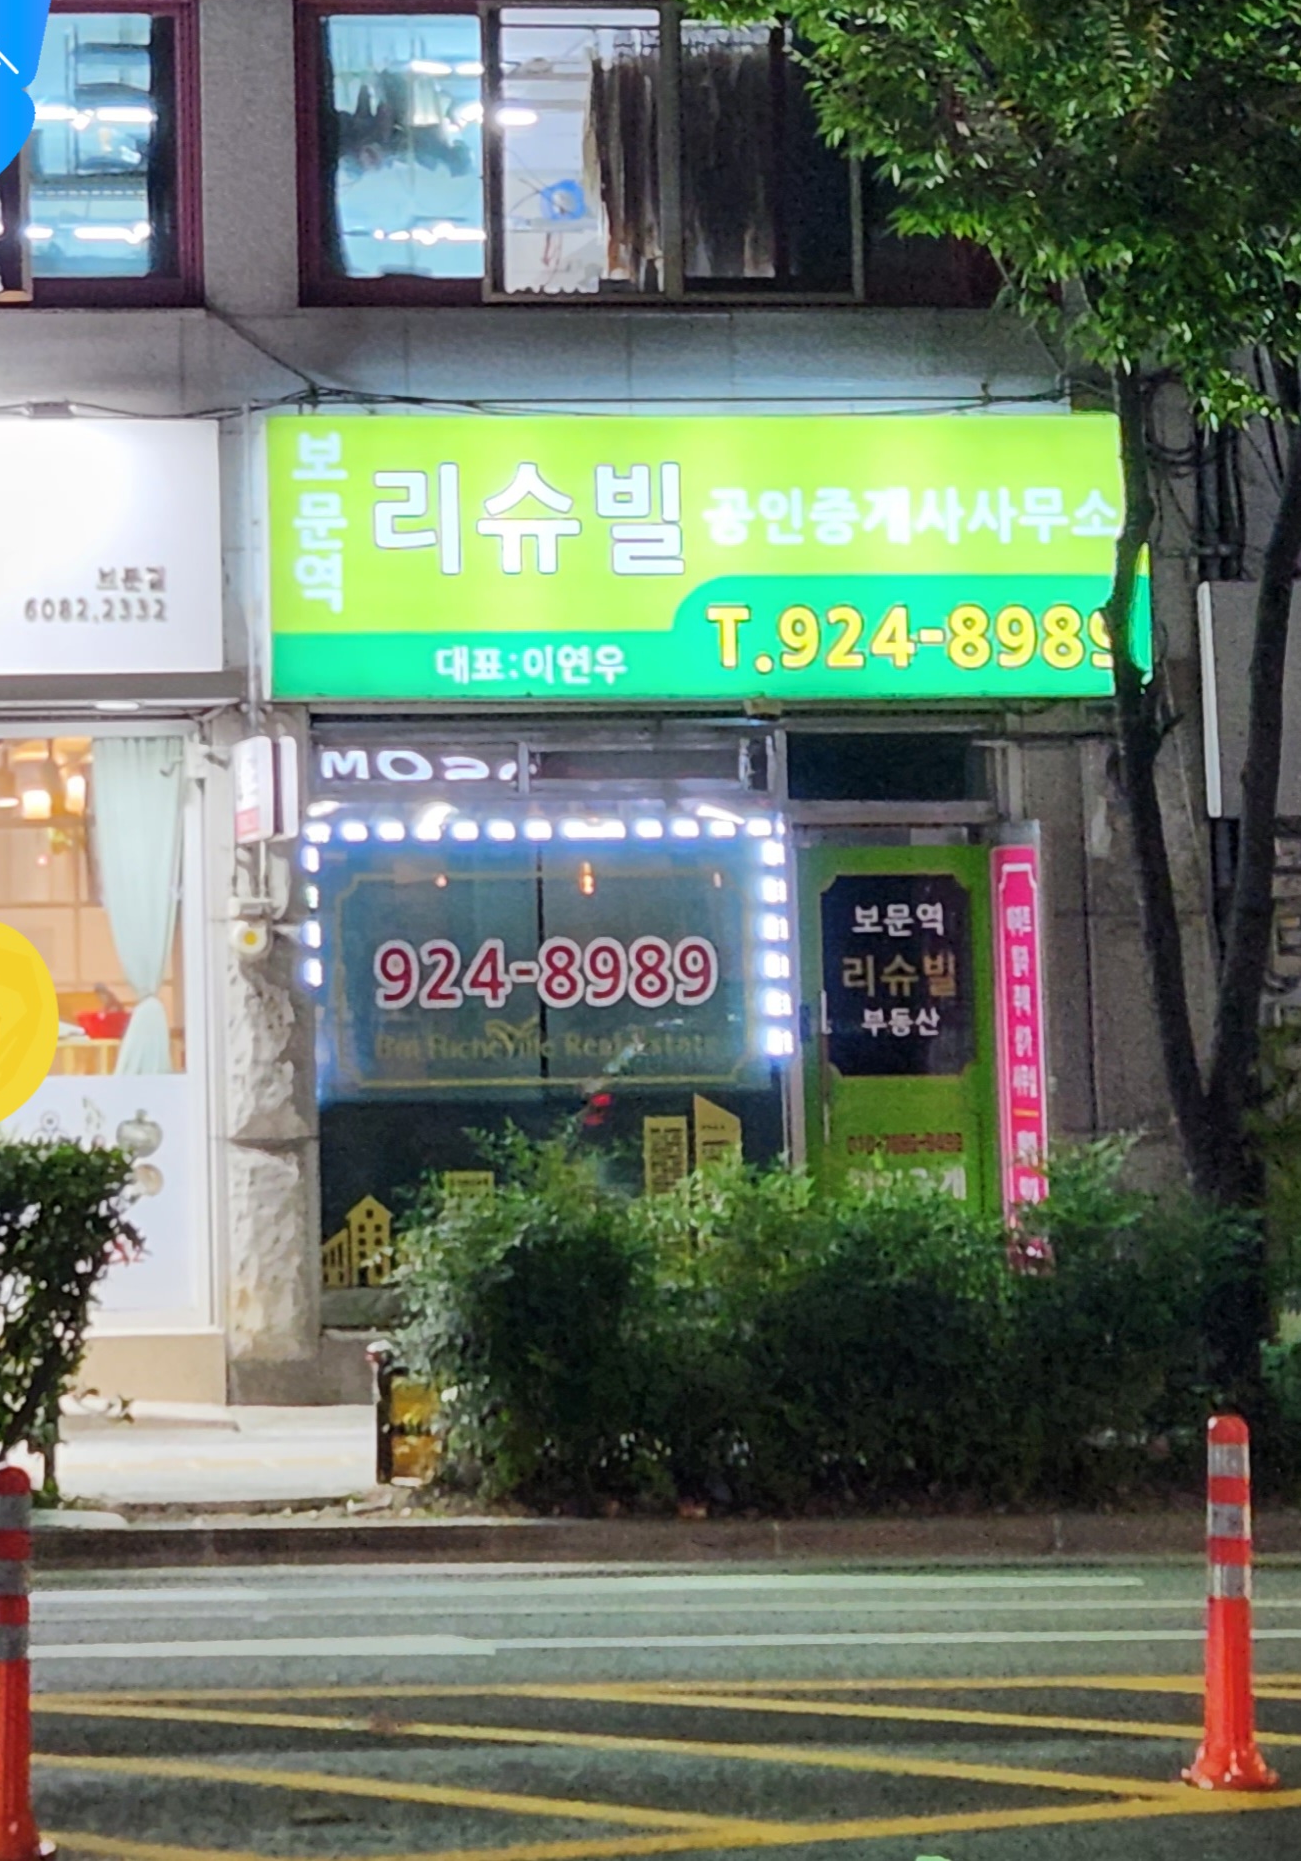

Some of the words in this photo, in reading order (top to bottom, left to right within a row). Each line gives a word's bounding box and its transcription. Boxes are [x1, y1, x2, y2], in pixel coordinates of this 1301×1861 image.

[291, 431, 349, 614] 보문역
[373, 461, 687, 576] 리슈빌
[851, 903, 945, 937] 보문역
[374, 937, 717, 1009] 924-8989
[842, 951, 957, 999] 리슈빌
[860, 1007, 941, 1037] 부동산
